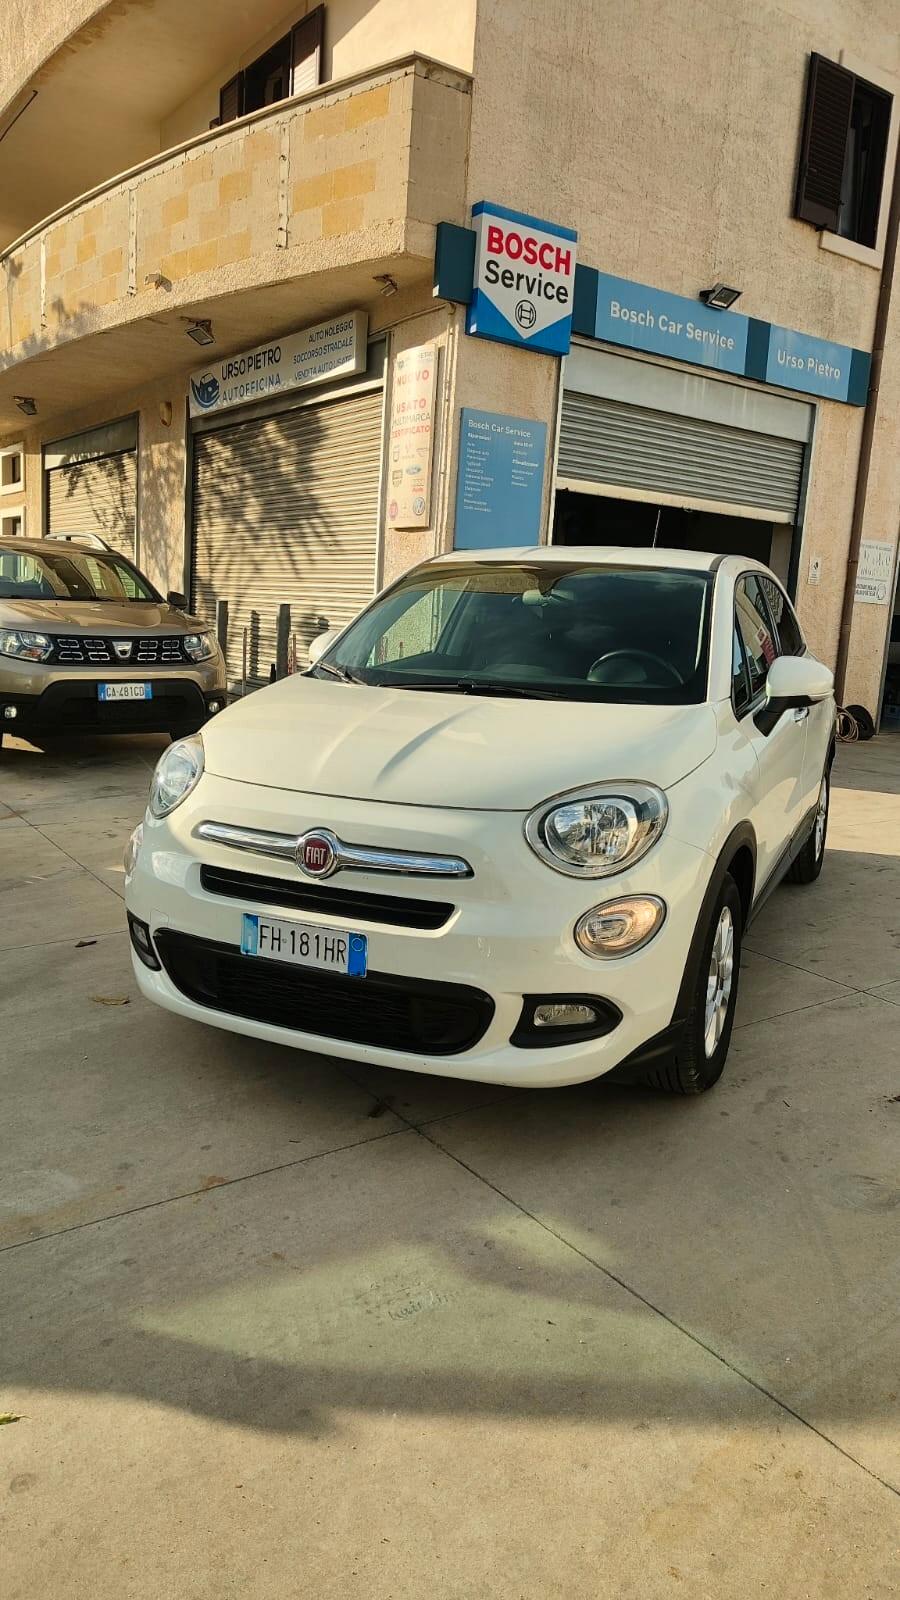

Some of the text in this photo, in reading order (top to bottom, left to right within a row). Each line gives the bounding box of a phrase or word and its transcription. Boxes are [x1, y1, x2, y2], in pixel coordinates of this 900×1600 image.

[486, 225, 571, 275] BOSCH
[484, 259, 569, 304] Service
[308, 319, 354, 343] AUTO NOLEGGIO
[609, 300, 735, 350] Bosch Car Service
[221, 346, 282, 381] URSO PIETRO
[293, 336, 354, 365] SOCCORSO STRADALE
[776, 349, 842, 380] Urso Pietro
[294, 366, 317, 381] VENDITA
[317, 360, 334, 374] AUTO
[222, 372, 281, 403] AUTOFFICINA
[395, 398, 427, 414] USATO
[467, 419, 532, 438] Bosch Car Service
[305, 846, 327, 865] FIAT
